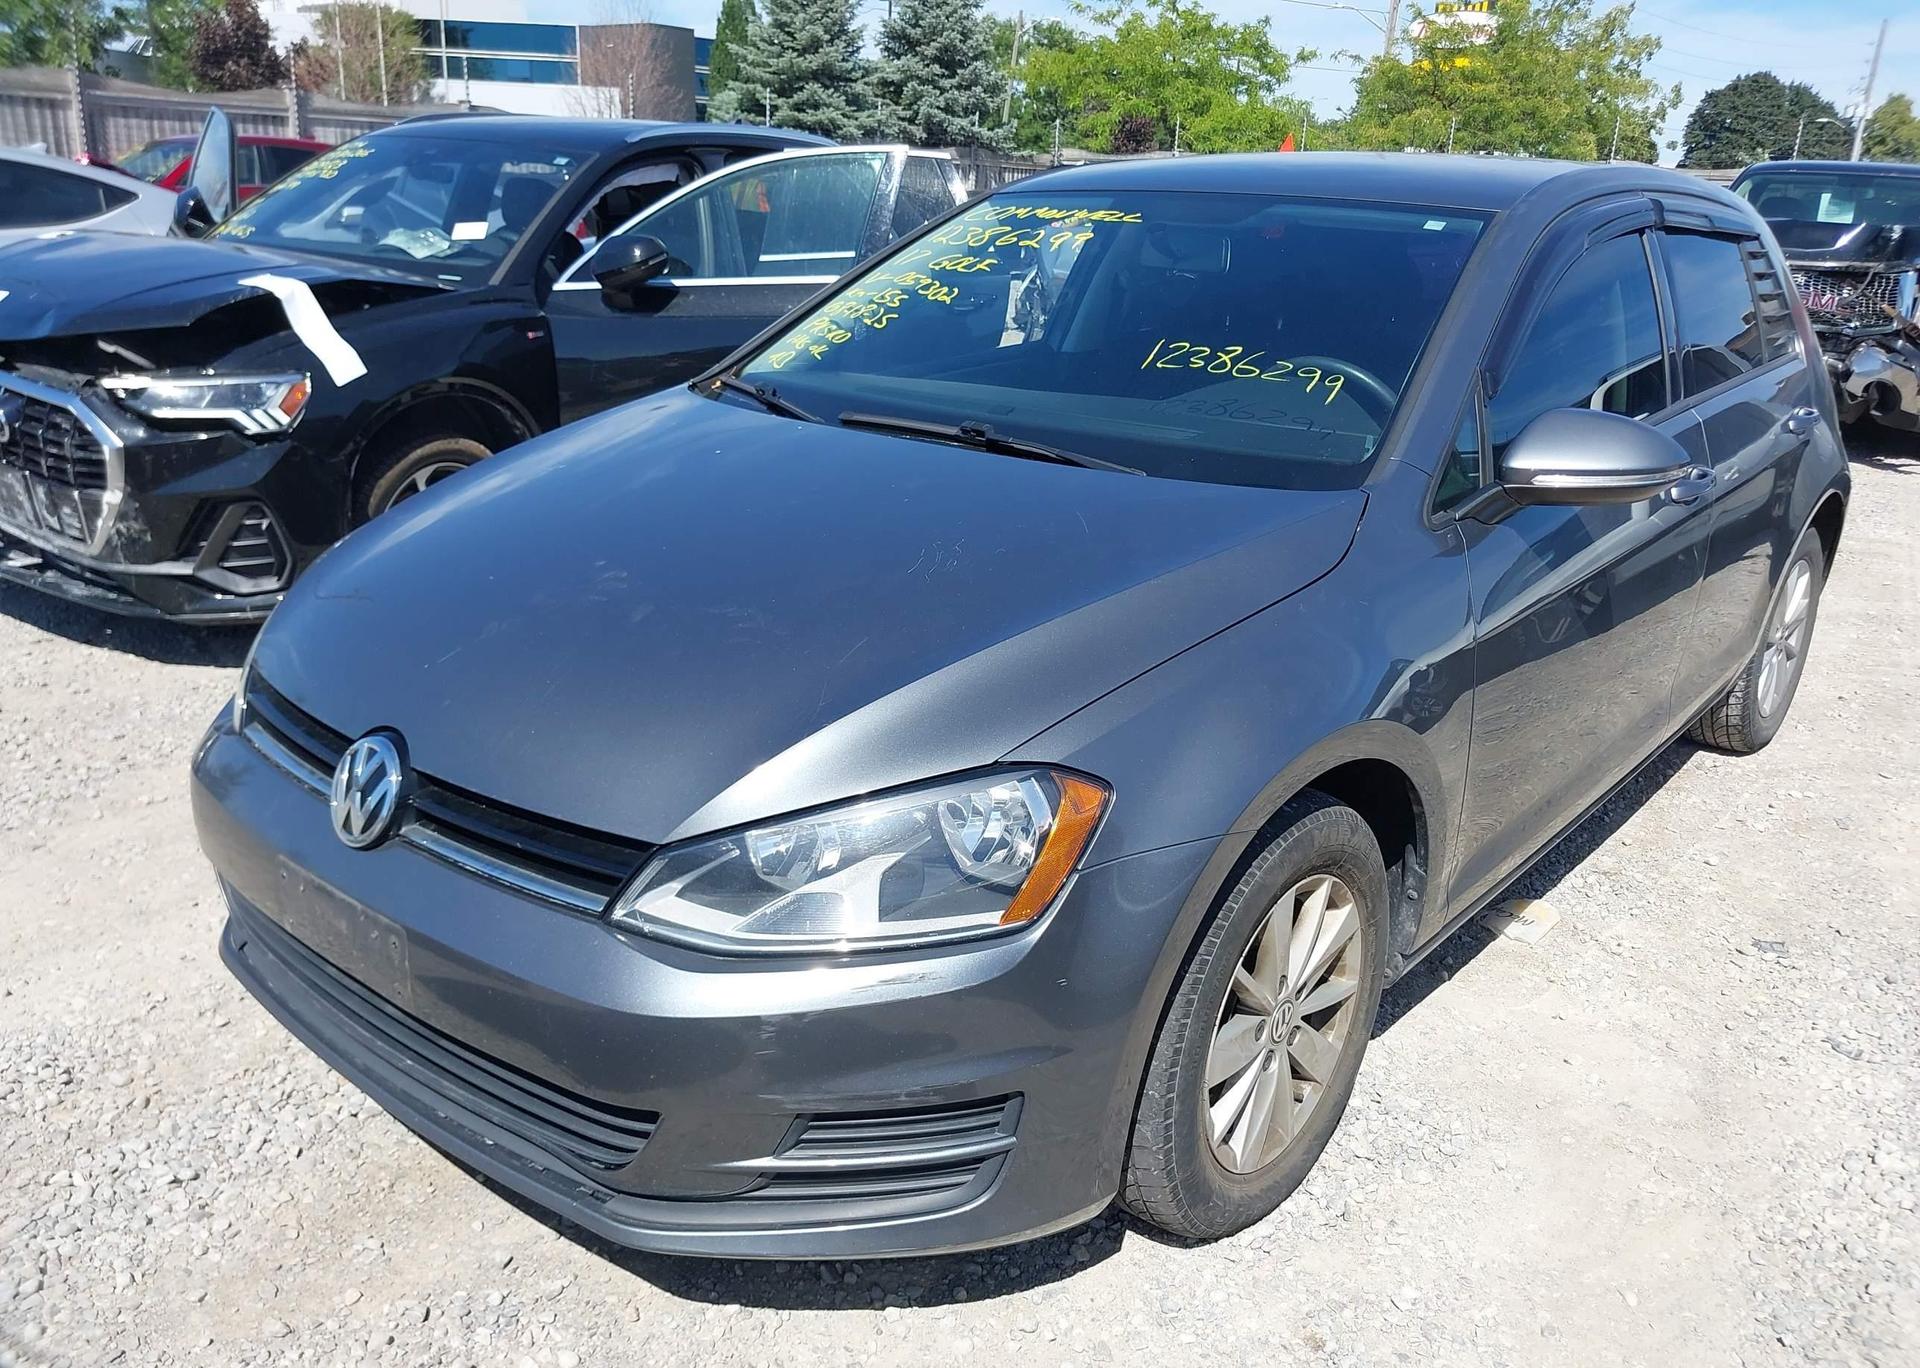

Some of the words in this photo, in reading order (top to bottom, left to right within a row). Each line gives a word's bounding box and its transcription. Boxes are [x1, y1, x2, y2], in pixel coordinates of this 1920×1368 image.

[926, 225, 1095, 252] 12386299
[928, 254, 998, 272] GOLF
[1140, 338, 1345, 406] 12386299
